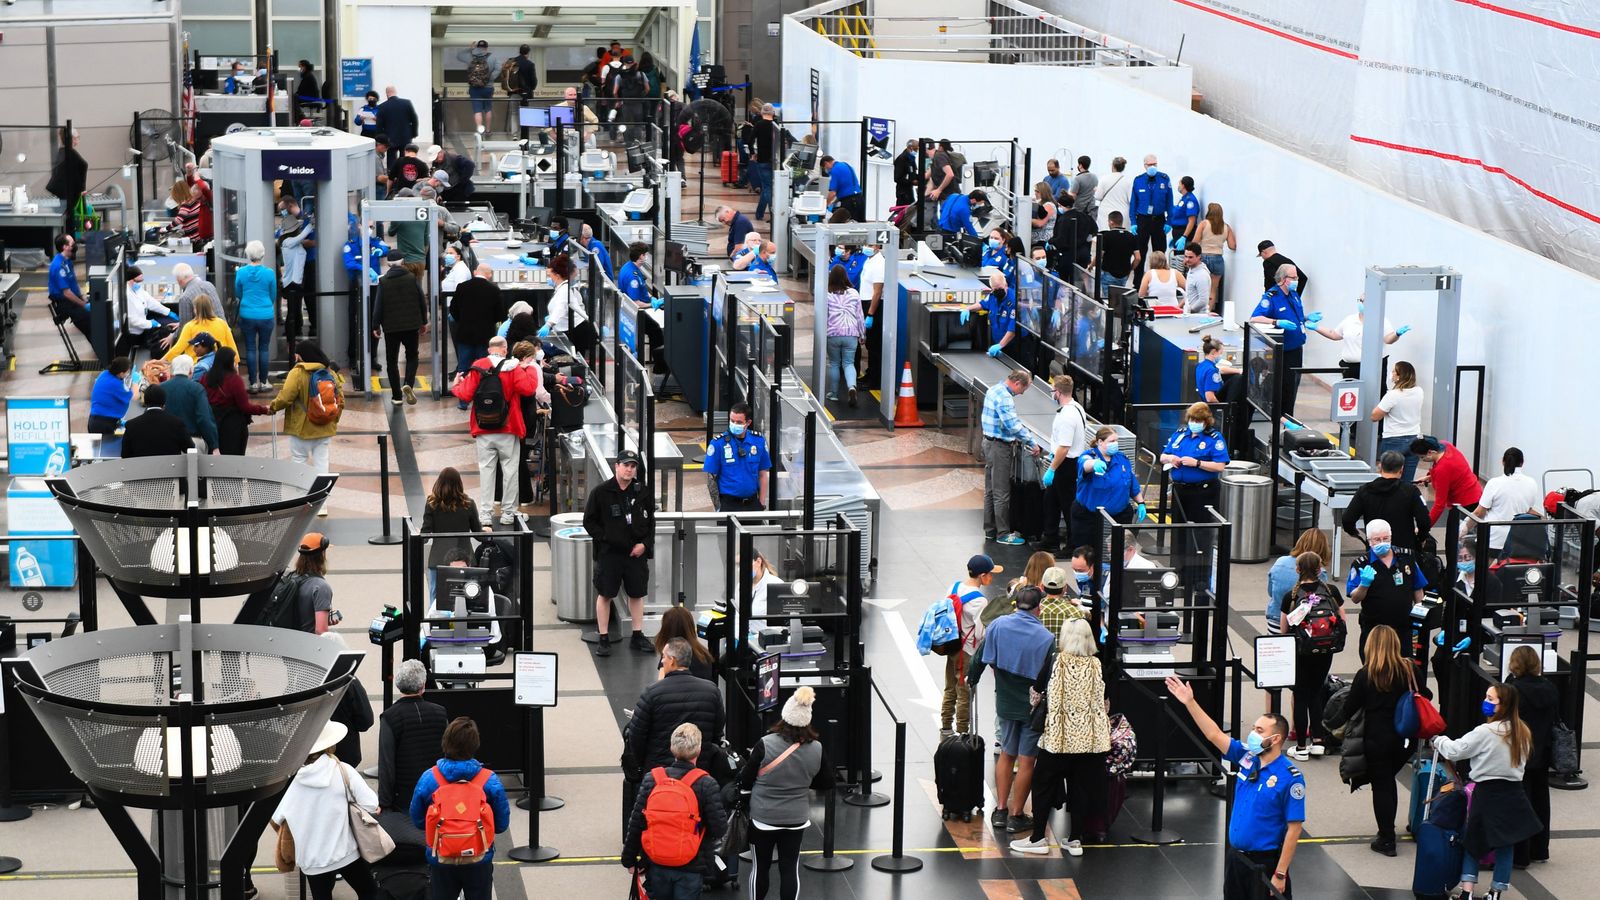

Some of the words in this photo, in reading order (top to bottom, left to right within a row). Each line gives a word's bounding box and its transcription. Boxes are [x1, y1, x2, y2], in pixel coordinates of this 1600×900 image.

[289, 166, 315, 174] leidos
[417, 207, 427, 220] 6
[878, 231, 888, 243] 4
[1440, 276, 1447, 289] 1
[14, 421, 47, 430] HOLD
[51, 421, 62, 430] IT
[14, 431, 49, 440] REFILL
[53, 432, 62, 440] IT
